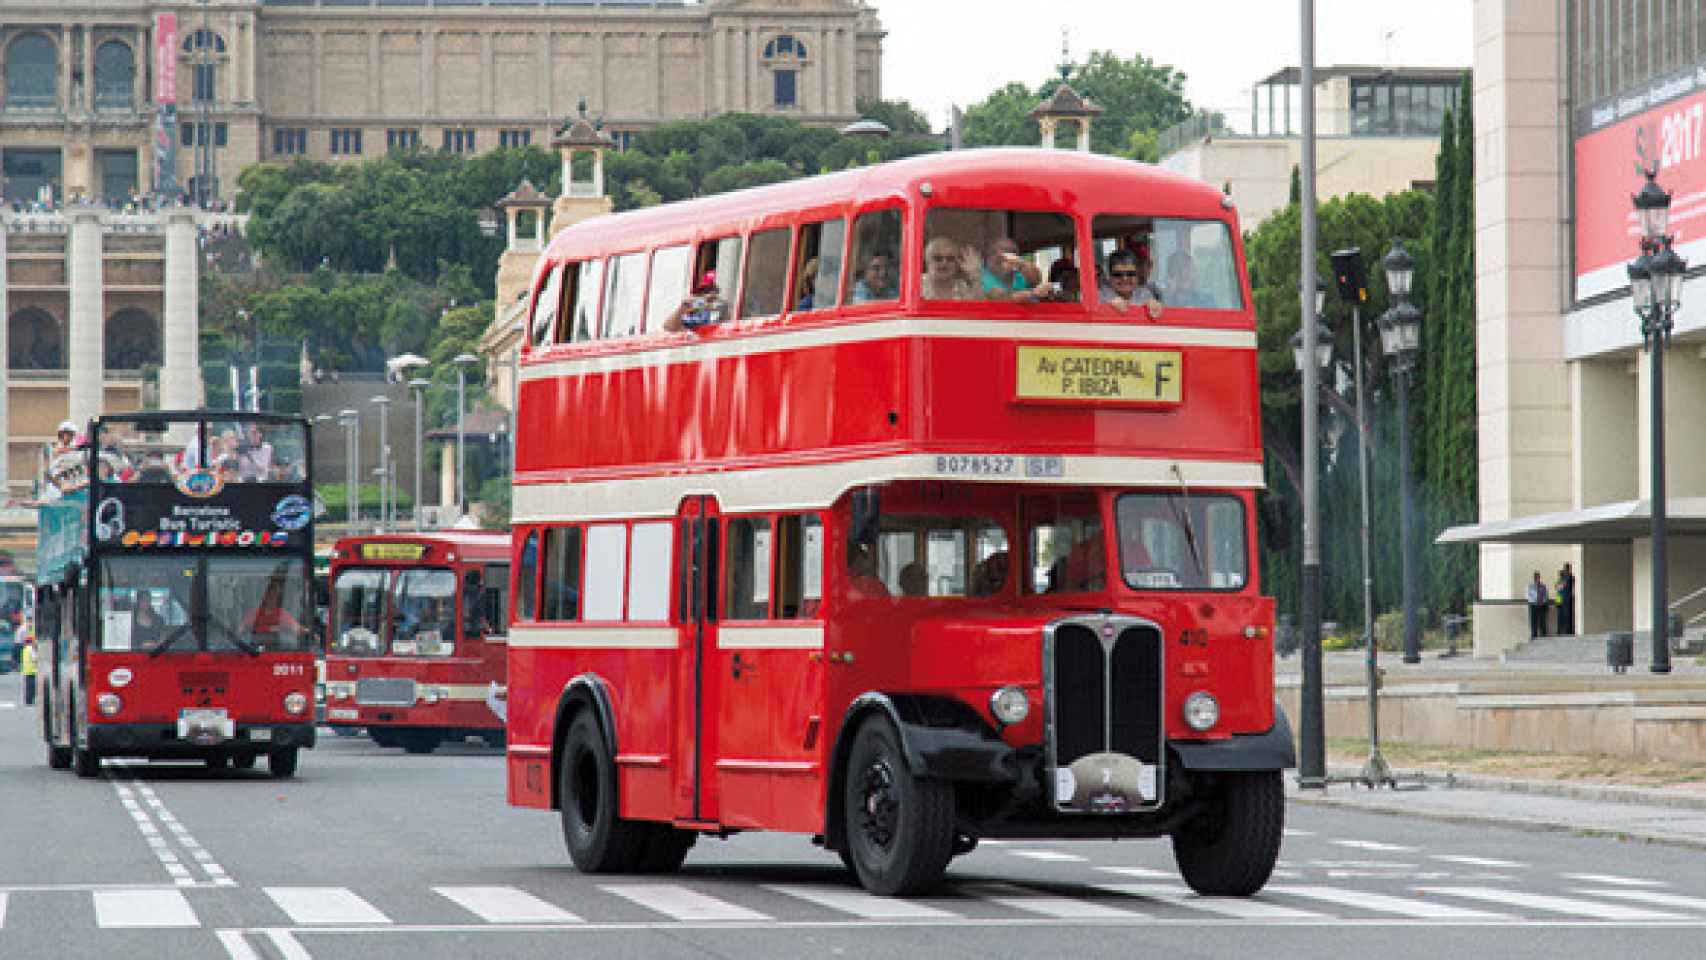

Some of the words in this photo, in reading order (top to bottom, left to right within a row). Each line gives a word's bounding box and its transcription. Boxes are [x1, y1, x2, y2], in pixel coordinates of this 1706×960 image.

[1662, 103, 1703, 168] 2017
[1037, 356, 1057, 374] Av
[1062, 358, 1144, 378] CATEDRAL
[1080, 378, 1120, 396] IBIZA
[1155, 360, 1173, 397] F
[159, 518, 187, 531] Bus
